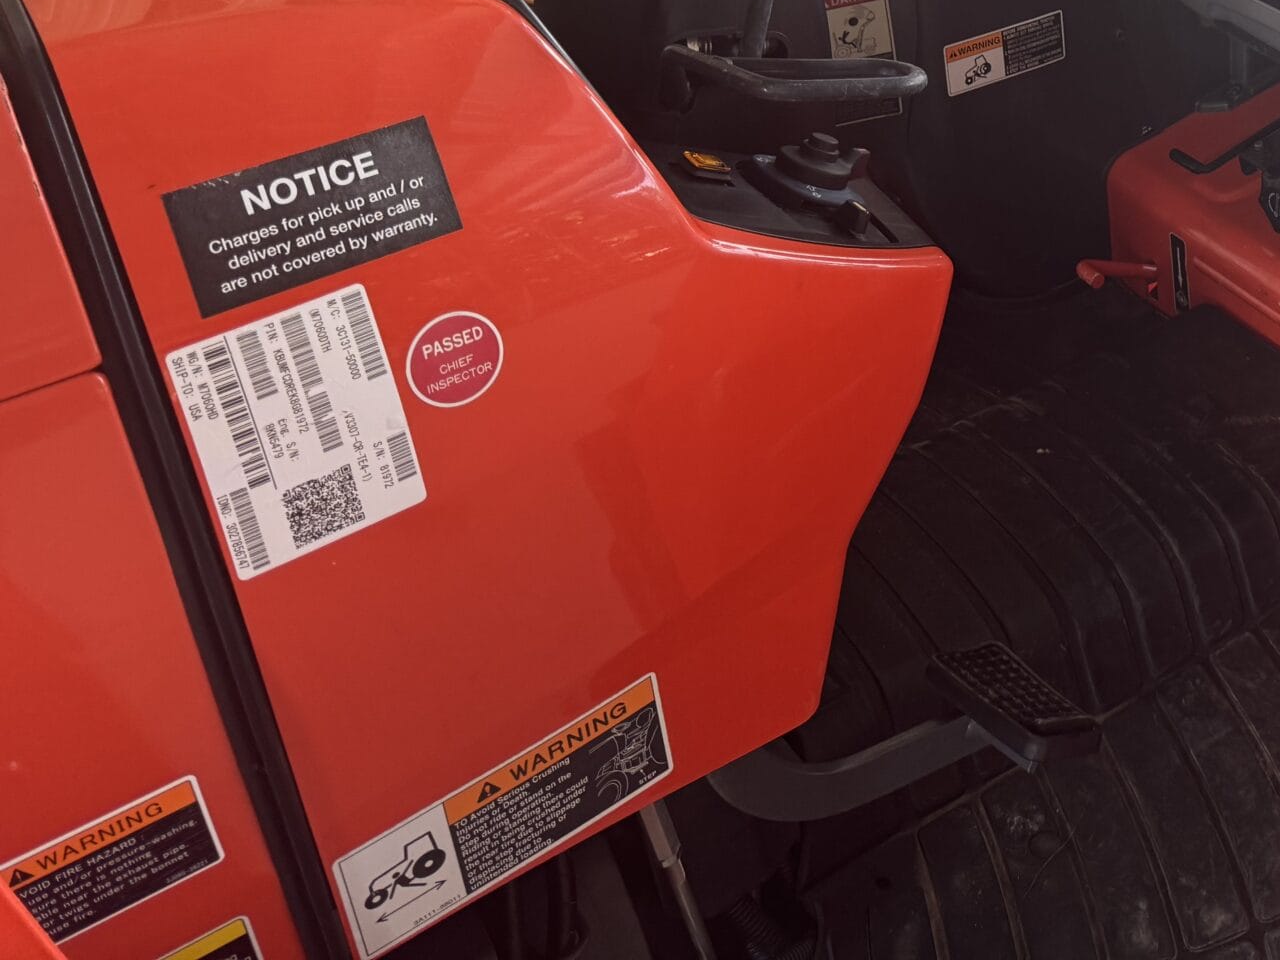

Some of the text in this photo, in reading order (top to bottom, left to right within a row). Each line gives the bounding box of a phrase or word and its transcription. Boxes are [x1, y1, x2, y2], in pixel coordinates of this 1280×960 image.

[957, 35, 1001, 56] WARNING
[209, 175, 425, 255] Charges for pick up and / or
[241, 151, 379, 215] NOTICE
[220, 214, 438, 294] are not covered by warranty.
[228, 196, 420, 270] delivery and service calls
[307, 306, 333, 354] (M7060DTH
[326, 298, 362, 381] M/C: 3C131-50000
[422, 326, 484, 360] PASSED
[170, 355, 203, 422] SHIP-TO: USA
[185, 350, 219, 421] WG/N: M7060HD
[263, 321, 309, 435] PIN: KBUMFCDREK8G81972
[426, 361, 492, 394] INSPECTOR
[438, 354, 474, 374] CHIEF
[263, 422, 285, 460] 8KN5479
[275, 417, 300, 463] Eng. S/N:
[371, 440, 394, 489] S/N: 81972
[215, 493, 251, 571] IDNO: 3027856747
[509, 698, 628, 782] WARNING
[454, 755, 570, 830] TO Avoid Serious Crushing
[458, 770, 571, 845] Do not ride or stand on the
[638, 769, 657, 785] STEP
[34, 799, 164, 872] WARNING
[456, 787, 530, 839] Injuries or Death.
[459, 789, 554, 853] step during operation.
[461, 775, 588, 860] Riding or standing there could
[463, 784, 586, 865] result in being crushed under
[465, 796, 580, 872] the rear tire due to slippage
[467, 812, 567, 879] or the step fracturing or
[18, 836, 137, 900] VOID FIRE HAZARD
[26, 891, 49, 907] use
[50, 868, 93, 895] and/or
[94, 816, 198, 874] pressure-washing.
[30, 897, 58, 915] sure
[60, 879, 92, 899] there
[94, 872, 107, 882] is
[108, 849, 152, 876] nothing
[34, 906, 60, 922] able
[62, 891, 89, 909] near
[91, 879, 112, 894] the
[114, 855, 159, 883] exhaust
[161, 840, 189, 859] pipe.
[41, 919, 54, 929] or
[58, 900, 90, 921] twigs
[91, 882, 126, 904] under
[127, 871, 148, 886] the
[150, 849, 189, 874] bonnet
[469, 835, 542, 886] displacing due to
[470, 835, 554, 891] unintended loading.
[48, 906, 97, 935] use fire.
